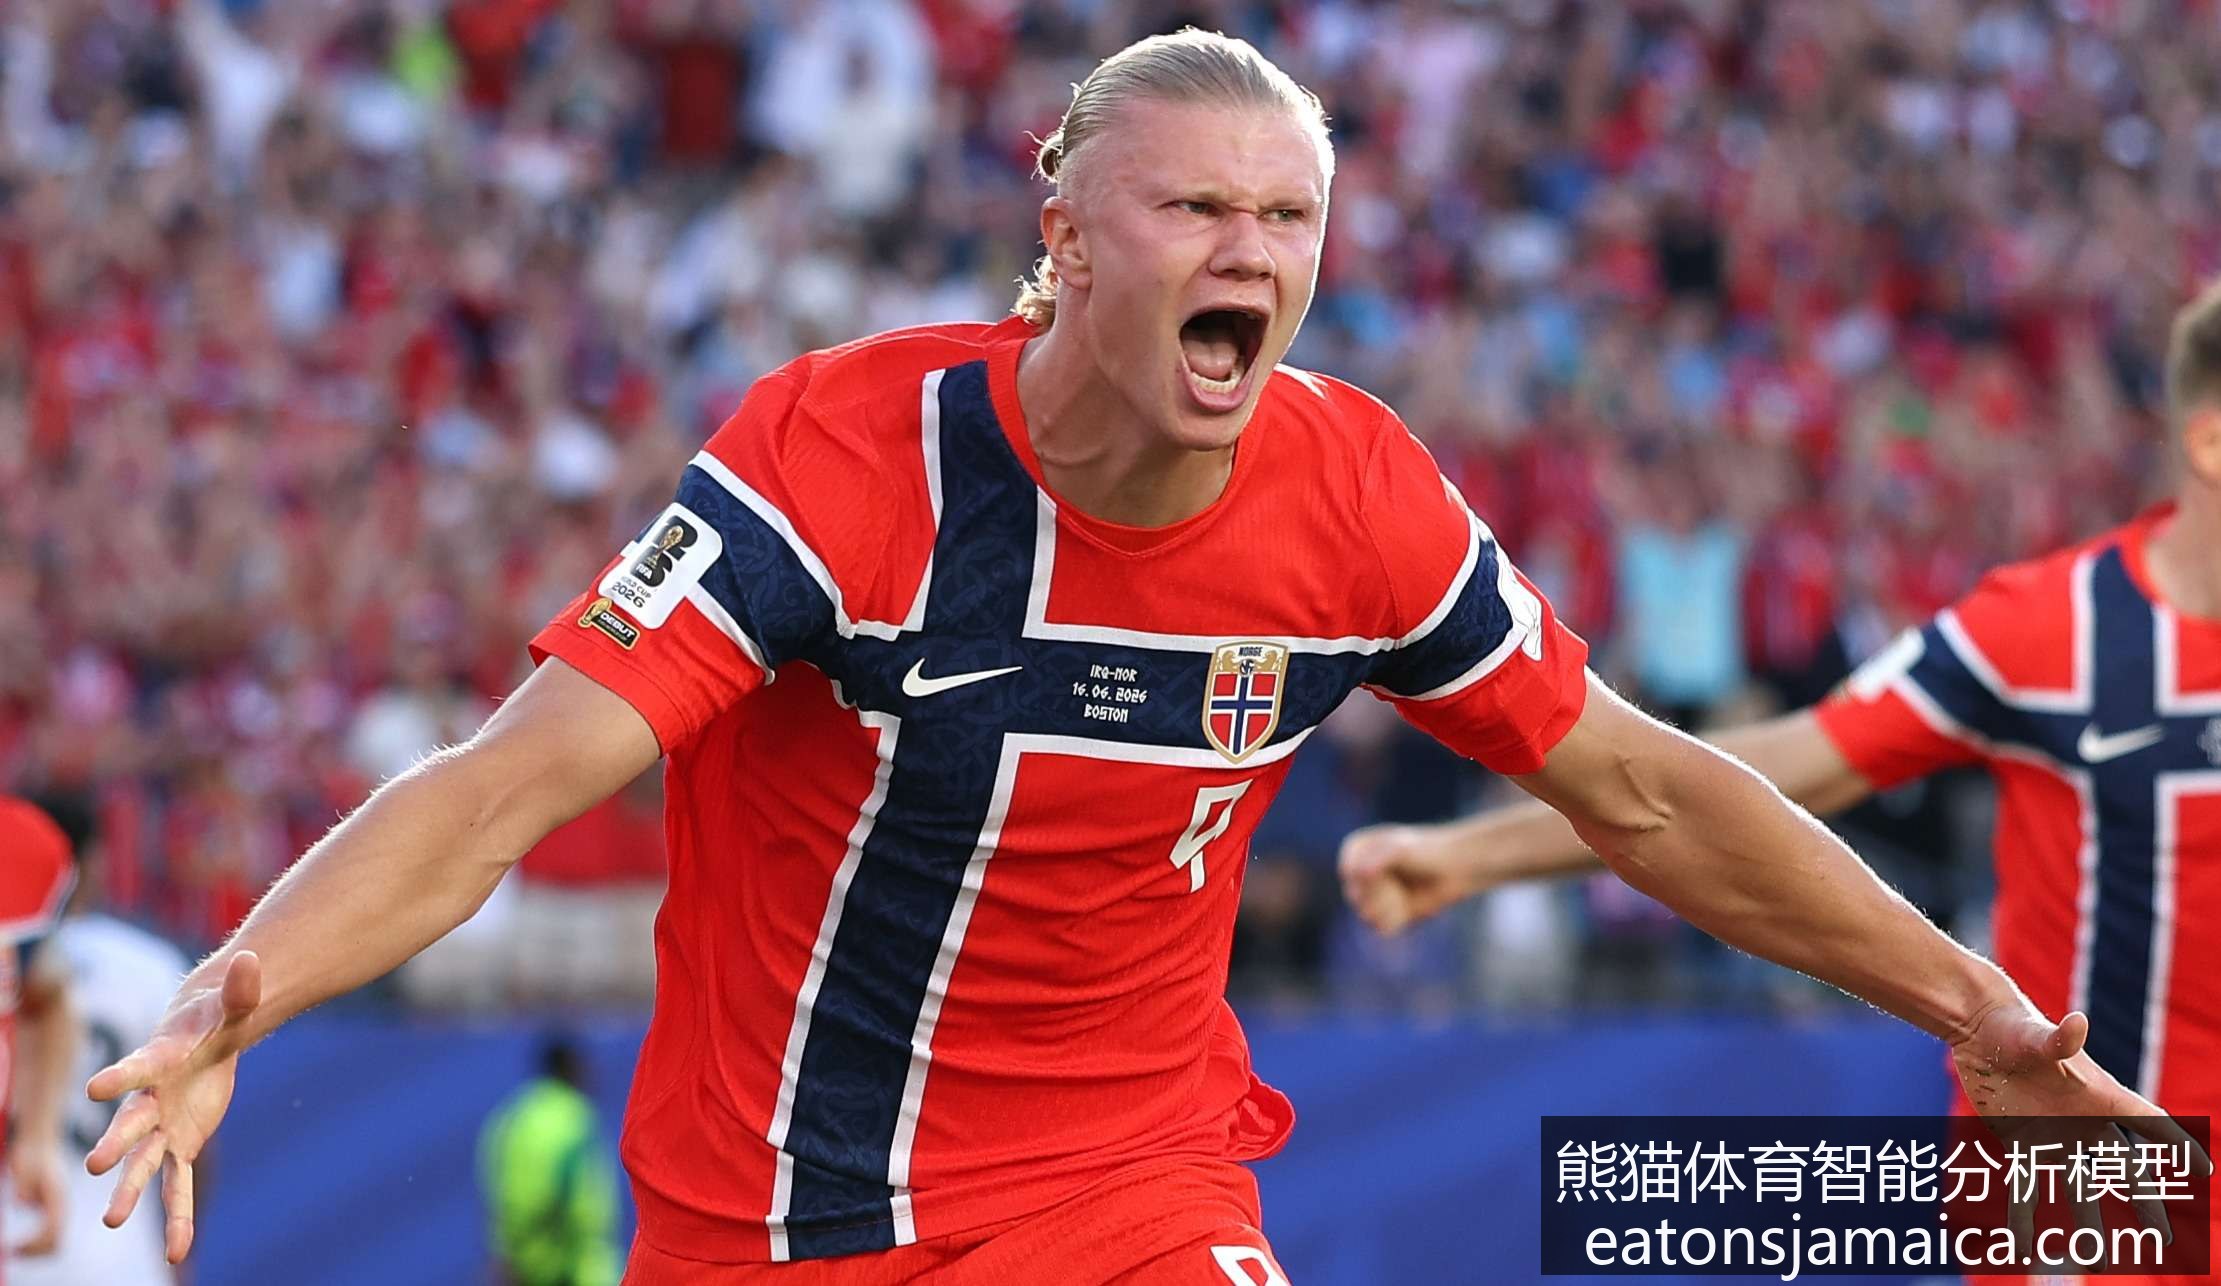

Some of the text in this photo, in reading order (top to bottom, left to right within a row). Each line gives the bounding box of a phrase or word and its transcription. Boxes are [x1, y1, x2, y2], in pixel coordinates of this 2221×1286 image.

[636, 563, 653, 580] FIFA
[611, 582, 646, 608] 2026
[636, 585, 652, 599] CUP
[600, 612, 636, 638] DEBUT
[1090, 664, 1138, 682] IRQ-NOR
[1083, 703, 1129, 723] BOSTON
[1169, 779, 1253, 893] 9
